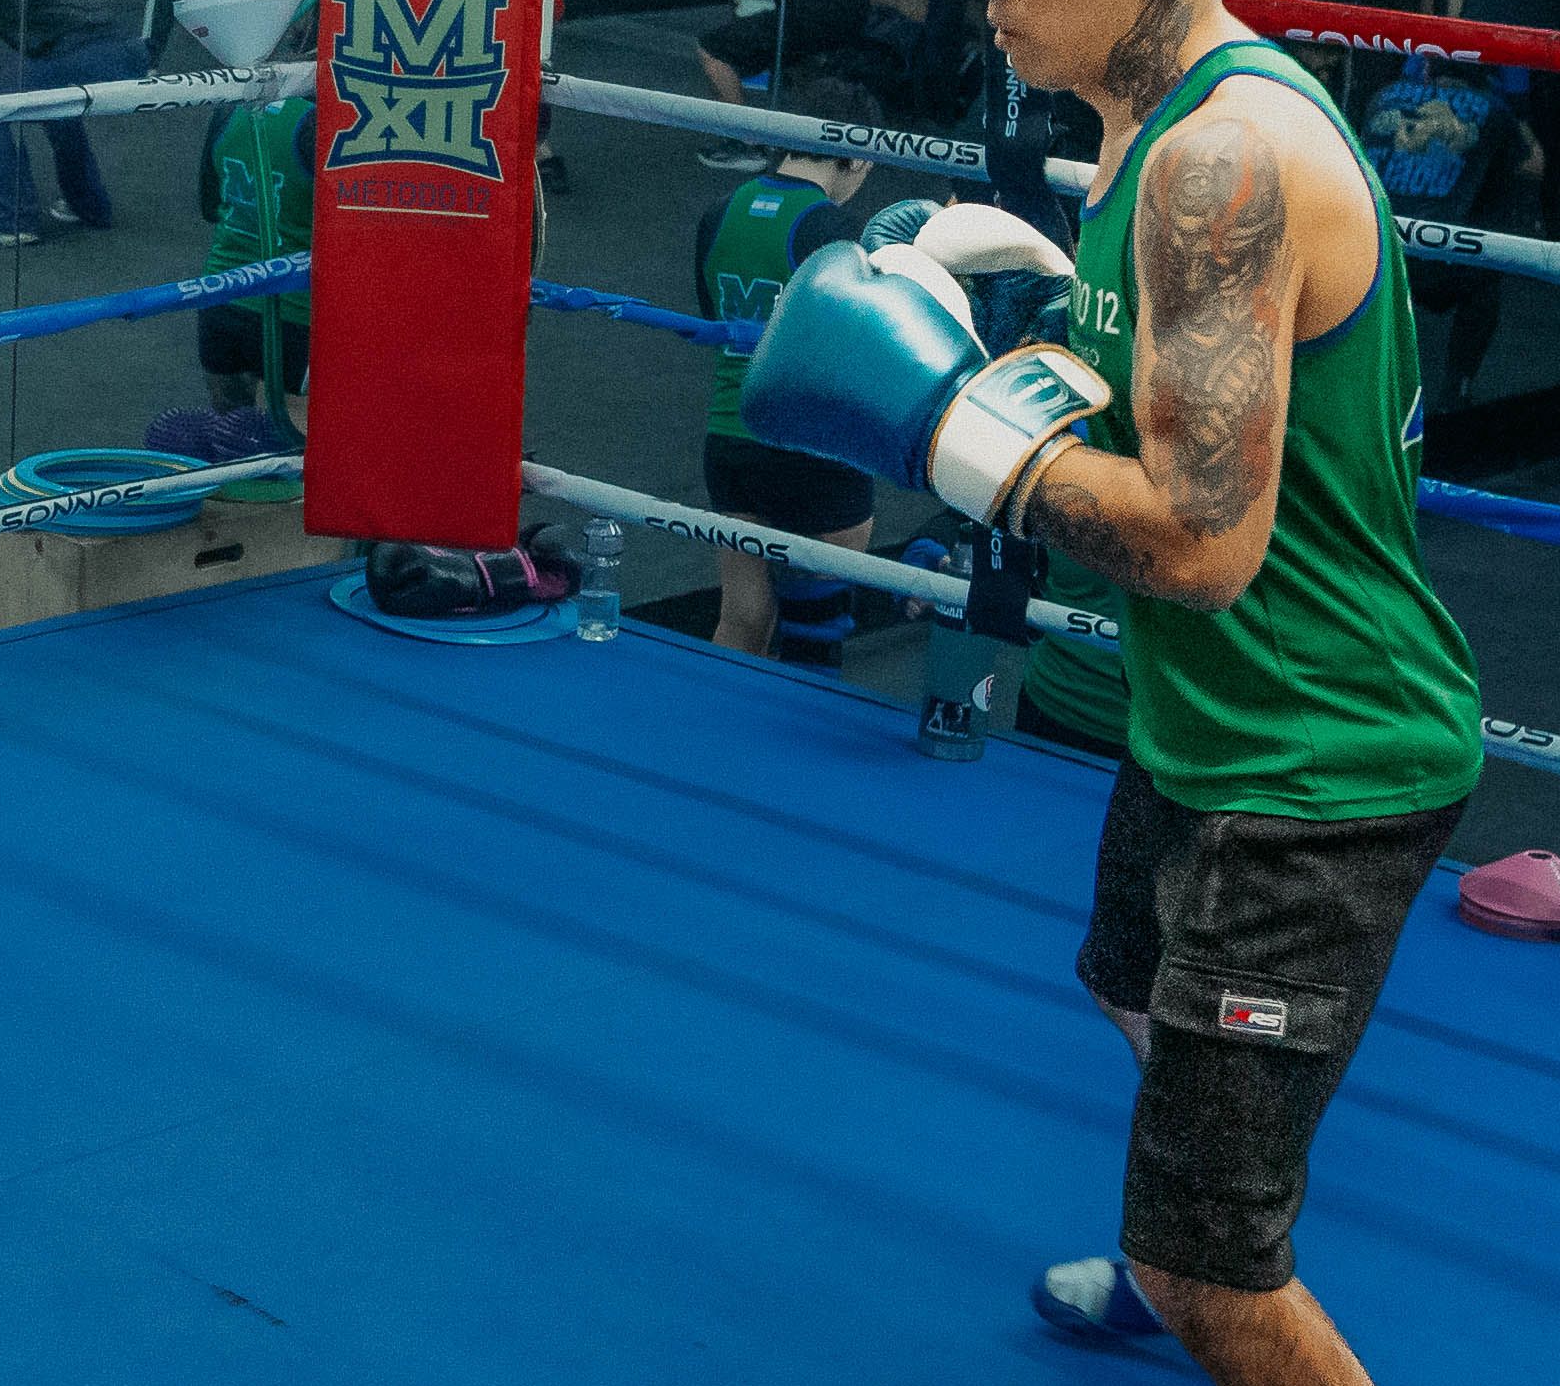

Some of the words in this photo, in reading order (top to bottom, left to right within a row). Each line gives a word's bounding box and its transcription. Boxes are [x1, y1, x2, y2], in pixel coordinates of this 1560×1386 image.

[820, 121, 982, 166] SONNOS
[467, 184, 492, 214] 12
[1392, 220, 1484, 254] NOS
[177, 251, 311, 300] SONNOS
[1096, 288, 1120, 335] 12
[2, 484, 144, 531] SONNOS
